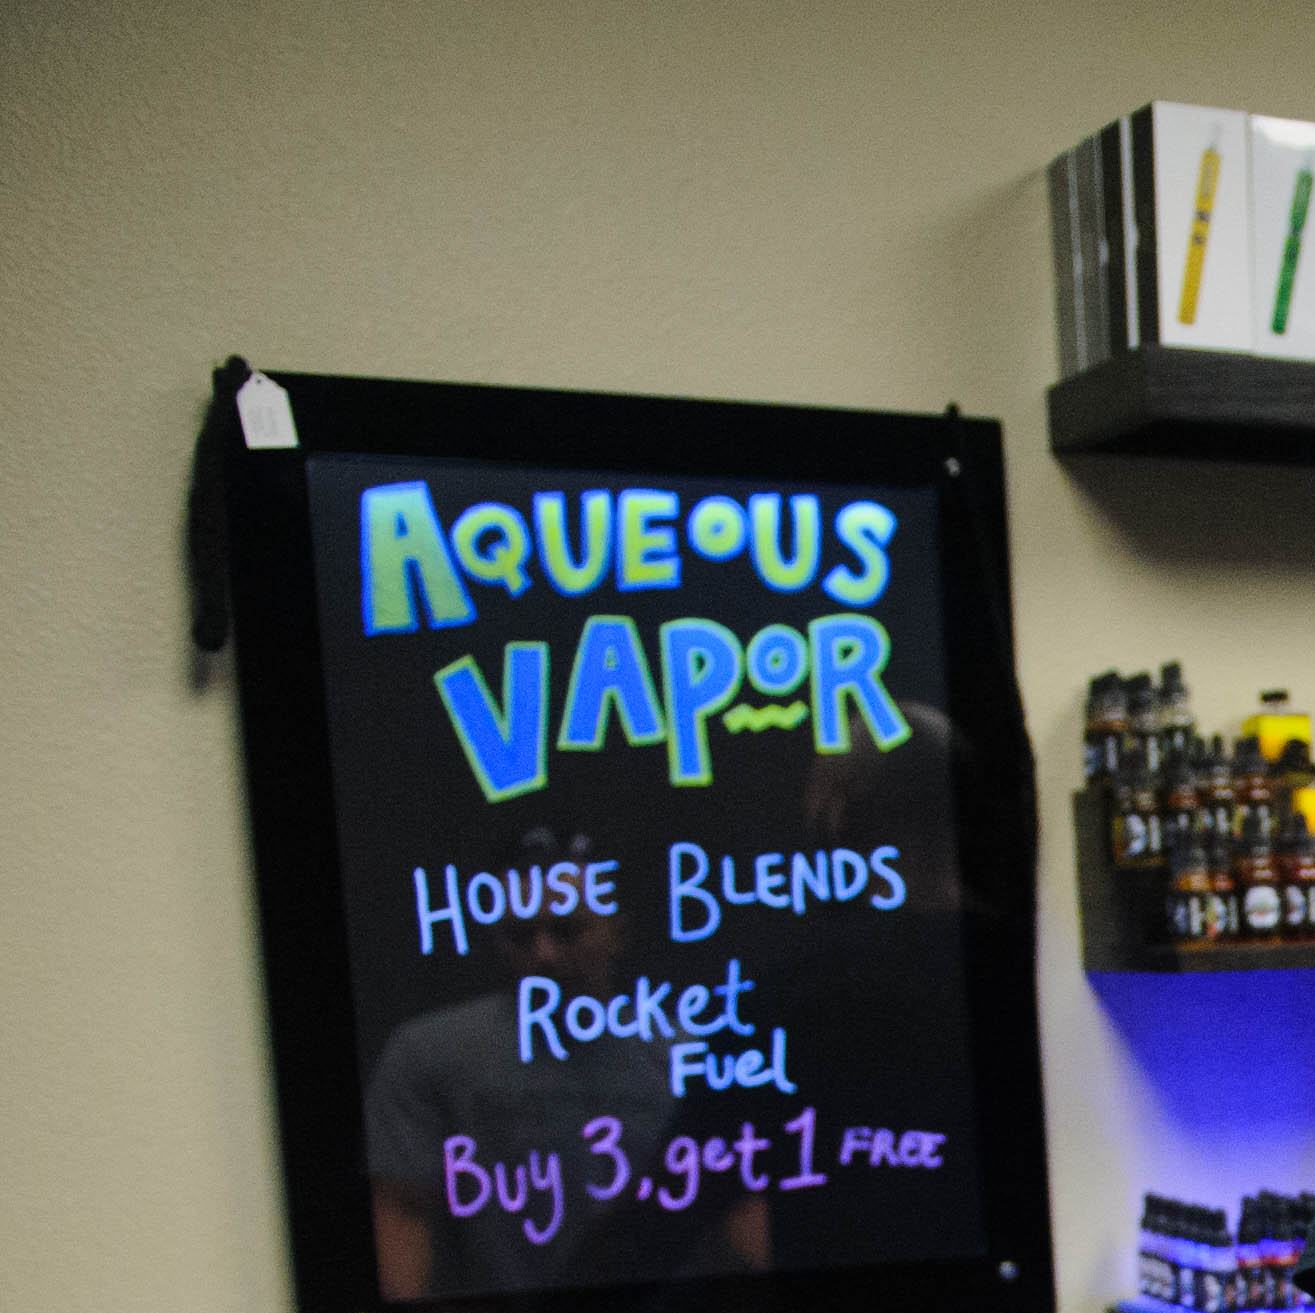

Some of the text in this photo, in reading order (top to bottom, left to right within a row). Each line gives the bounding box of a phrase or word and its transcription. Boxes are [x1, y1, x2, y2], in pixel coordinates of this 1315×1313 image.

[358, 479, 898, 636] AQUEOUS
[434, 613, 911, 802] VAPOR
[412, 841, 907, 956] HOUSE BLENDS
[517, 958, 755, 1063] Rocket
[669, 1026, 797, 1098] Fuel
[443, 1134, 564, 1245] Buy
[779, 1106, 827, 1191] 1
[839, 1126, 947, 1169] FREE
